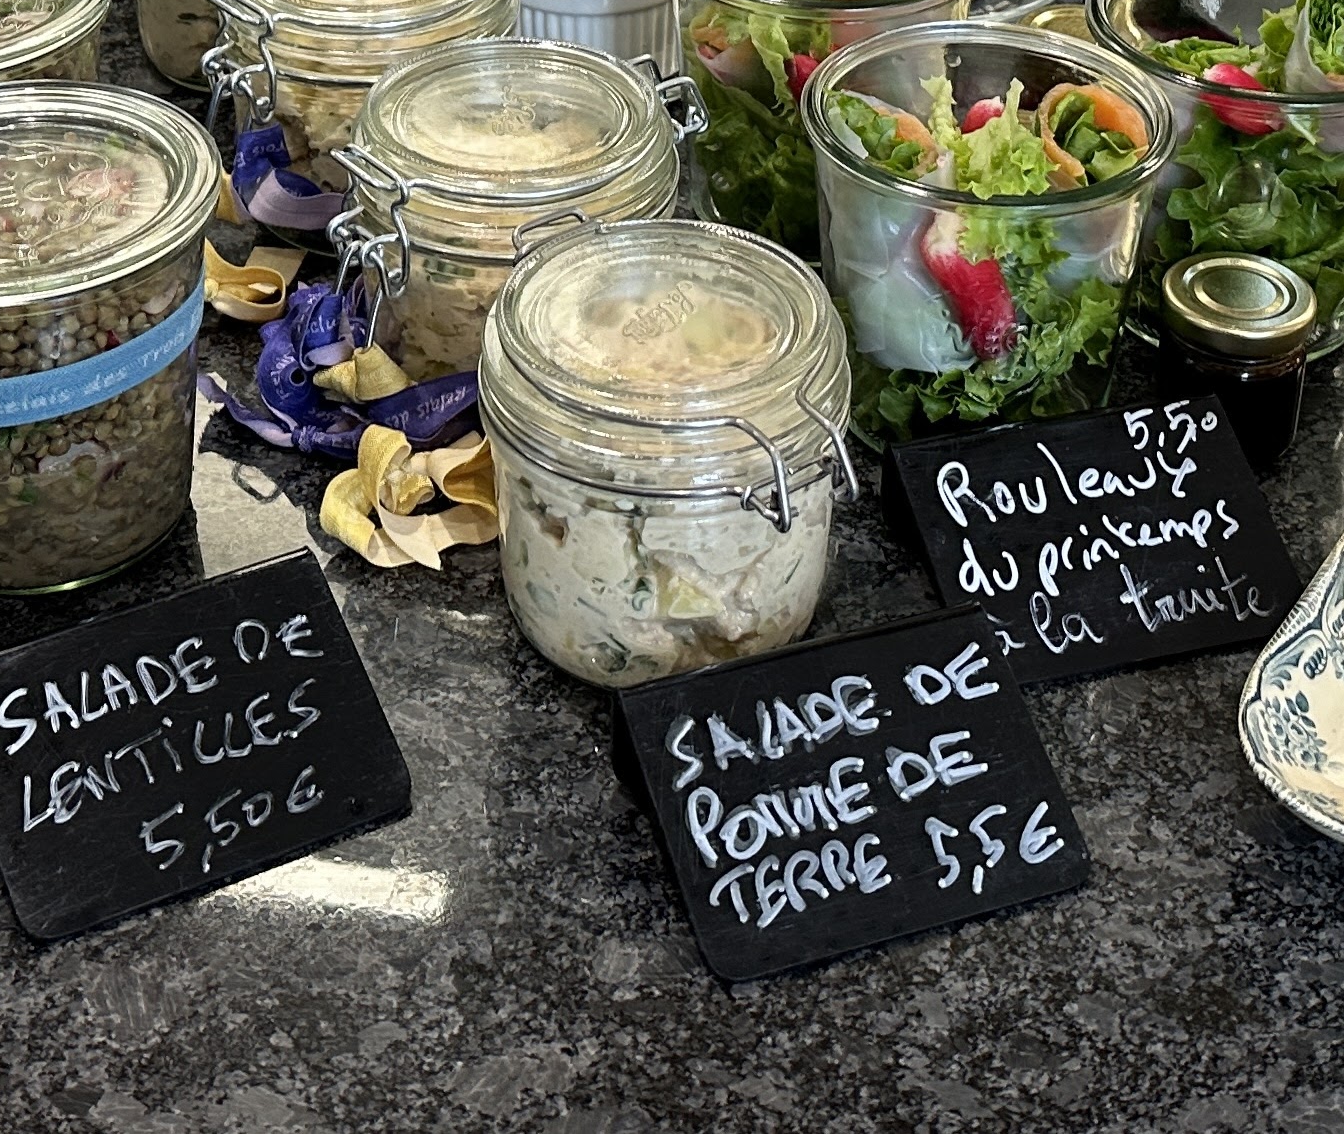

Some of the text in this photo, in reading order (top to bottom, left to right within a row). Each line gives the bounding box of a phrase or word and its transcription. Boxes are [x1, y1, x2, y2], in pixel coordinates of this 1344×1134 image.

[958, 499, 1241, 597] du printemps
[231, 613, 325, 665] DE
[1029, 591, 1105, 655] la
[22, 676, 322, 833] LENTILLES
[664, 641, 1001, 791] SALADE DE
[885, 730, 990, 802] DE
[708, 831, 893, 929] TERRE
